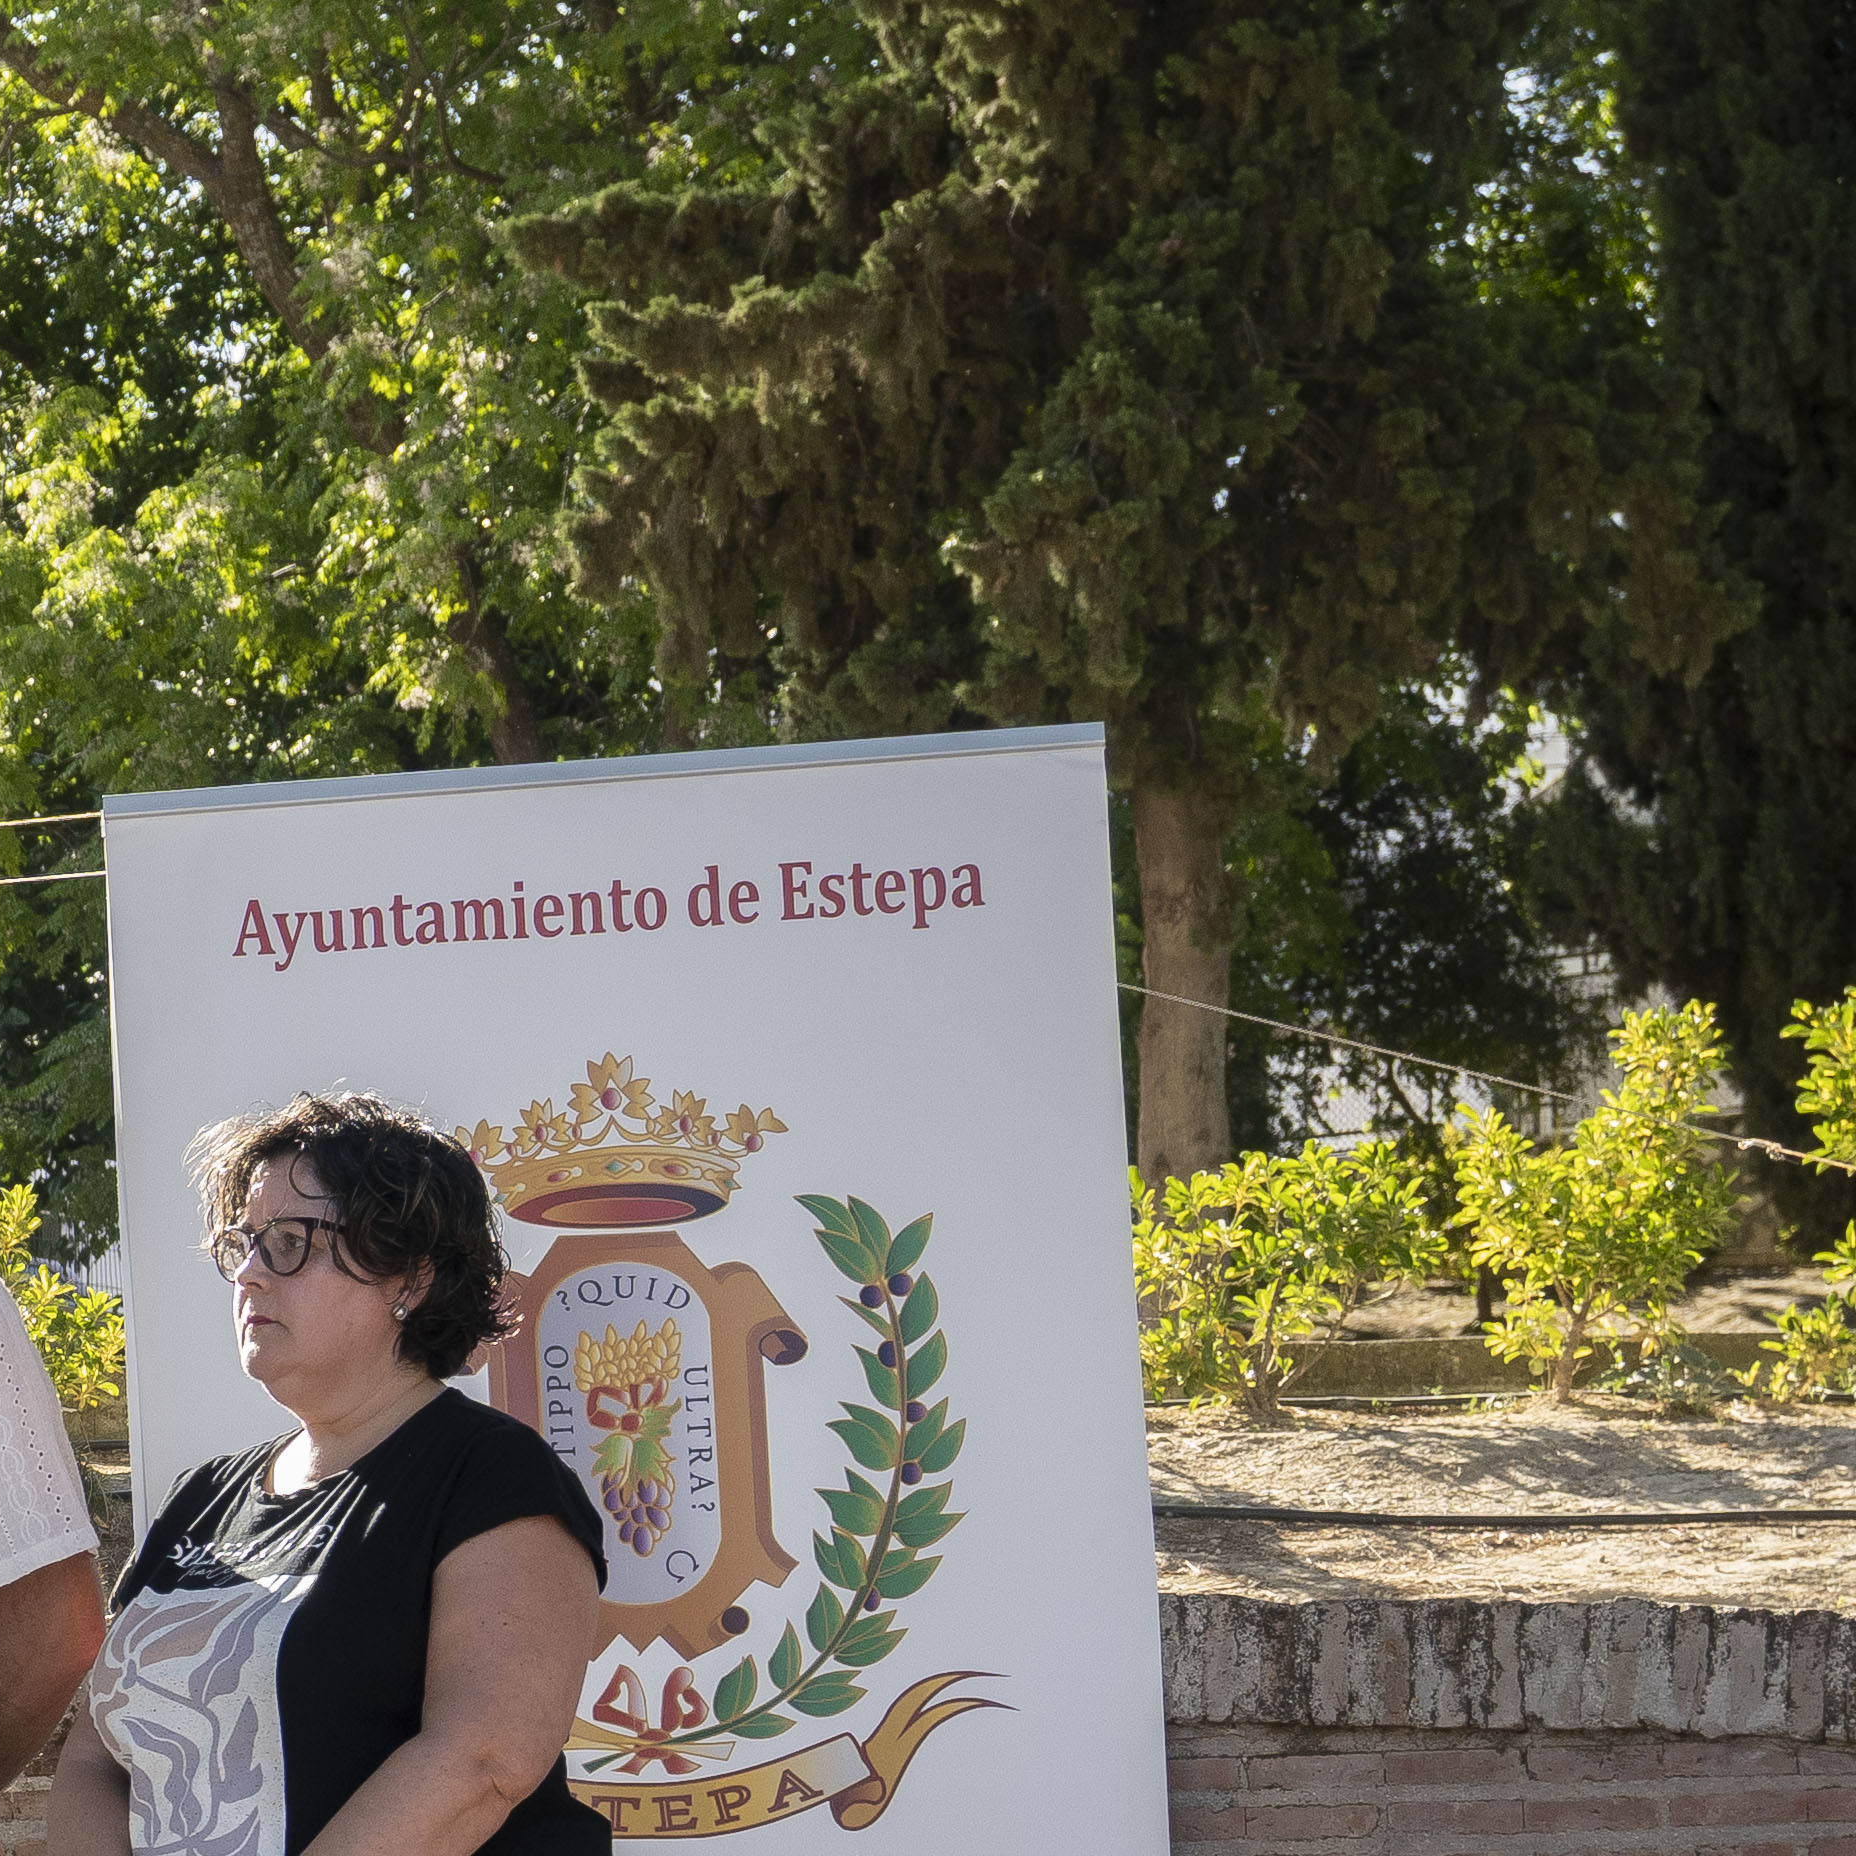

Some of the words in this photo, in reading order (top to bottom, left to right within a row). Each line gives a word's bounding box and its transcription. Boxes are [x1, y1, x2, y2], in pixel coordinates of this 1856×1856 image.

[232, 880, 668, 972] Ayuntamiento
[688, 865, 760, 926] de
[778, 861, 986, 929] Estepa
[684, 1364, 715, 1513] ULTRA?
[572, 1768, 824, 1832] TEPA
